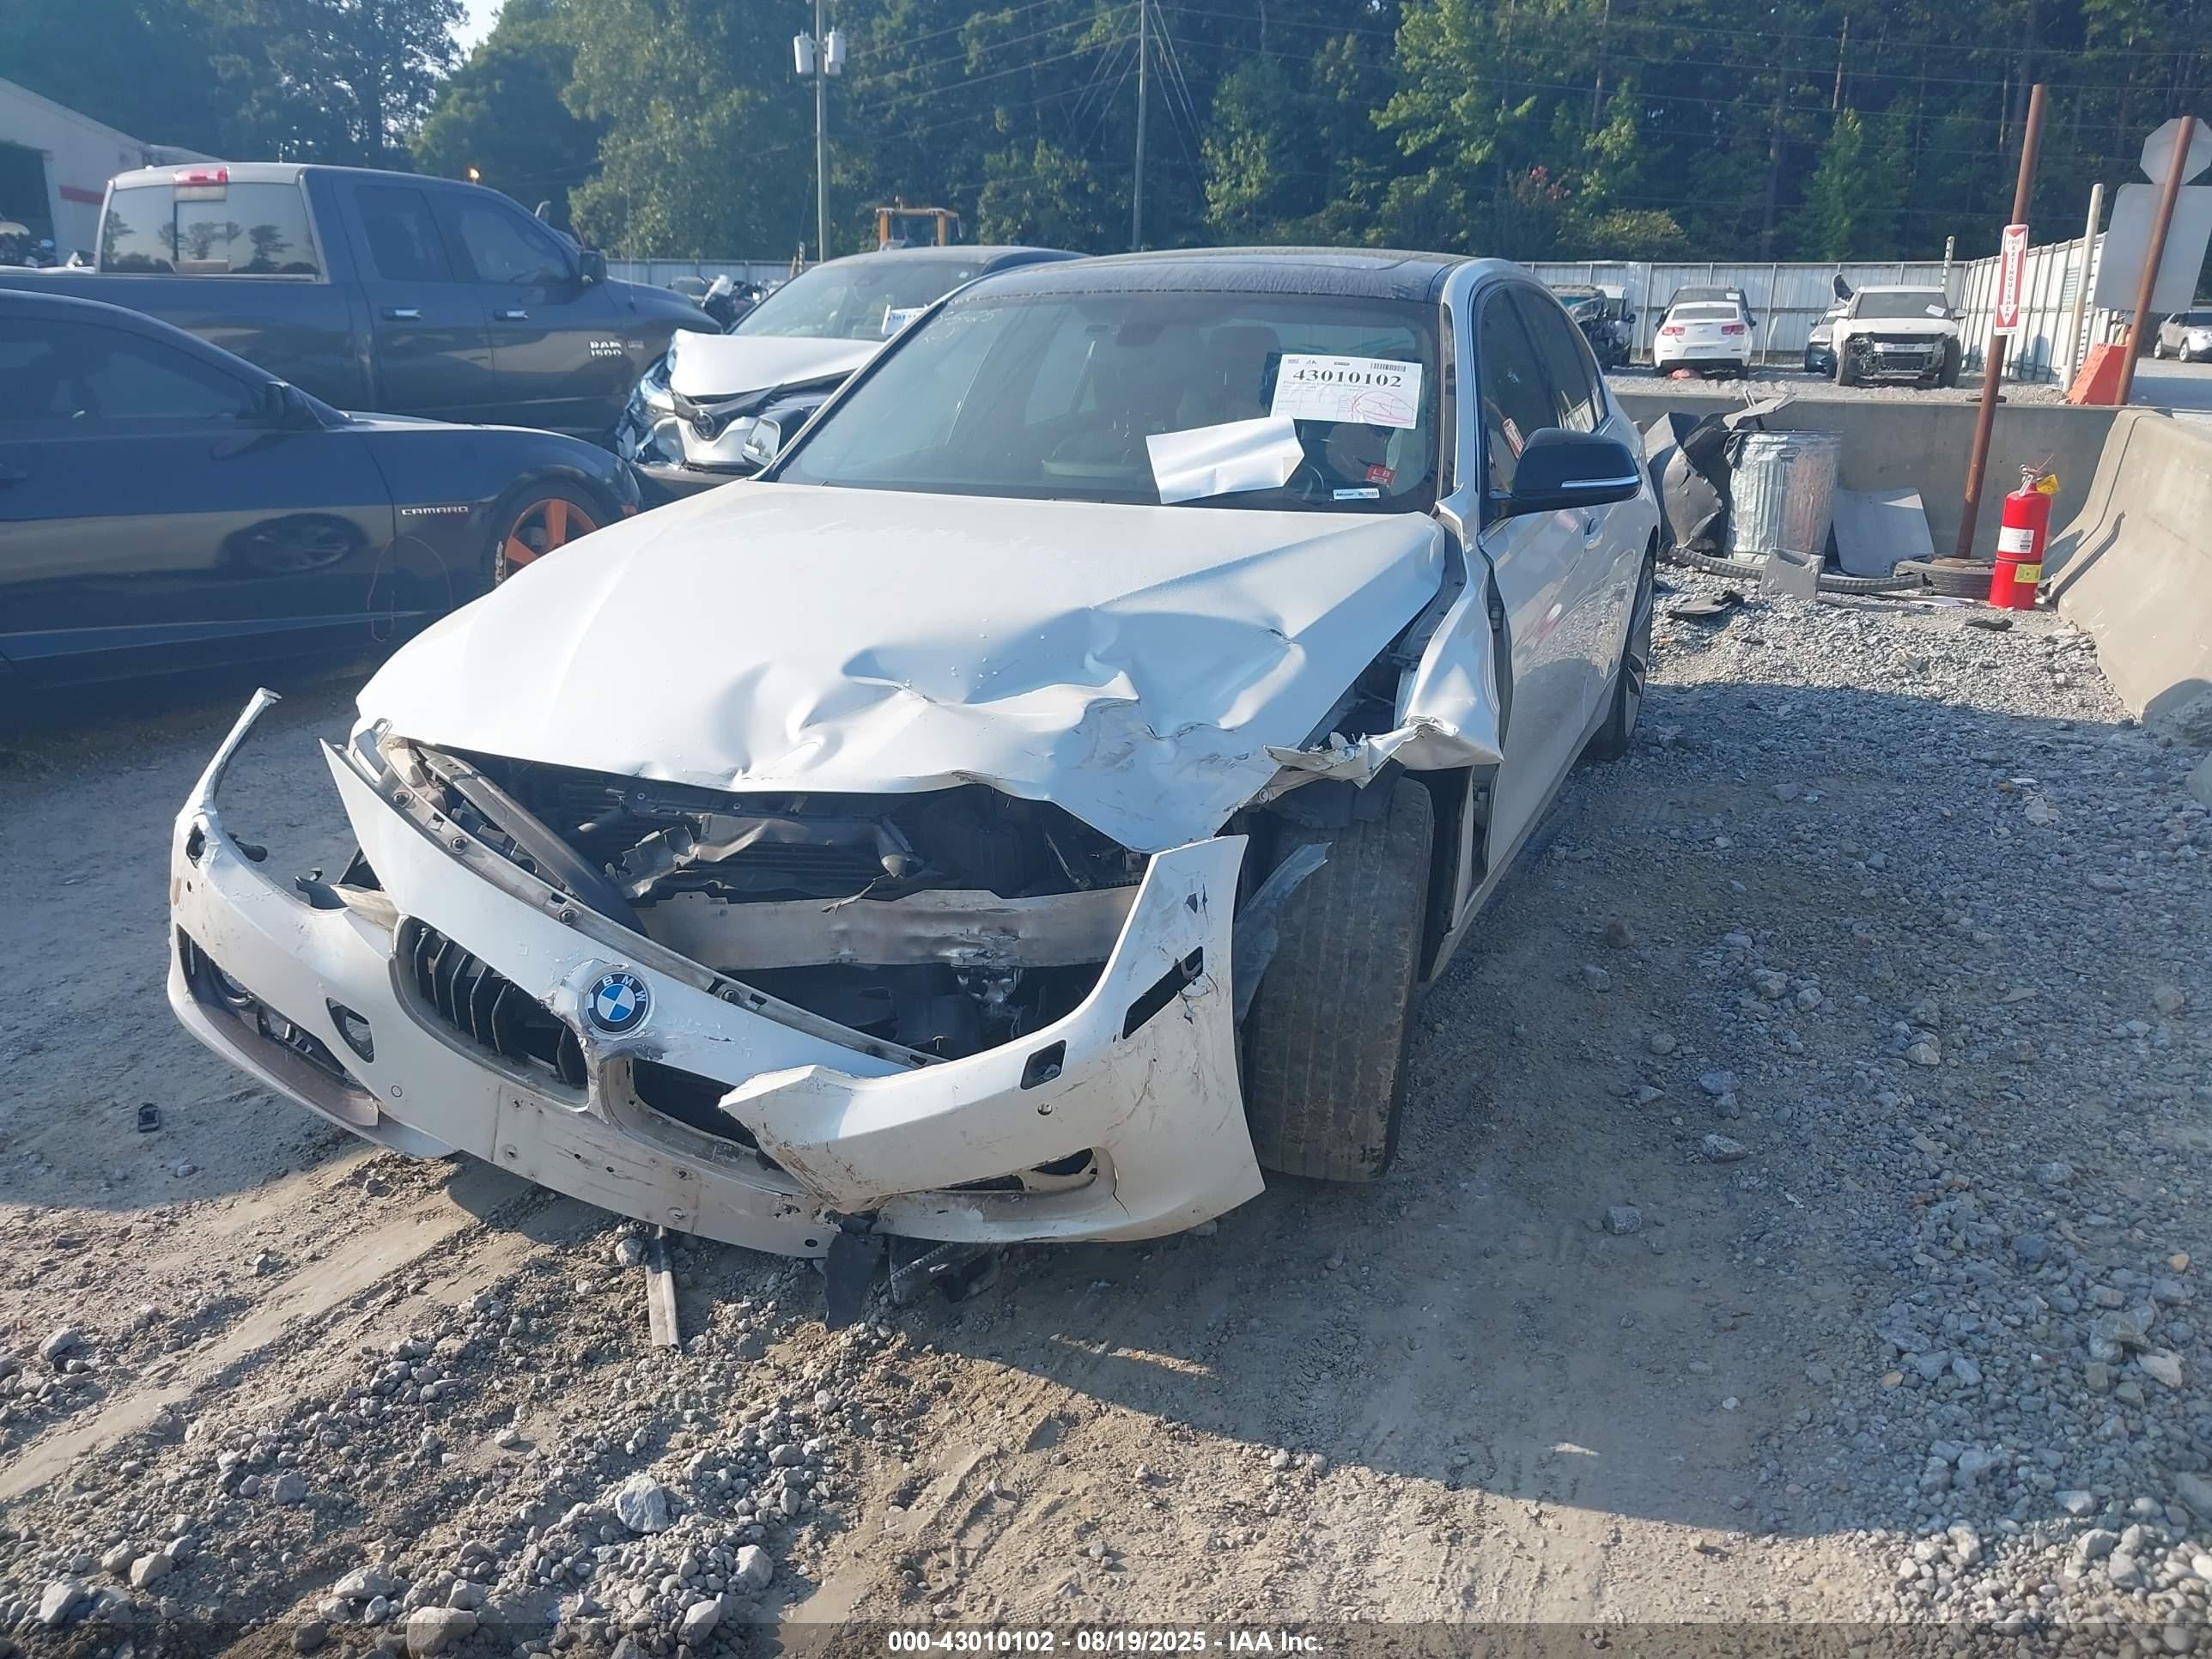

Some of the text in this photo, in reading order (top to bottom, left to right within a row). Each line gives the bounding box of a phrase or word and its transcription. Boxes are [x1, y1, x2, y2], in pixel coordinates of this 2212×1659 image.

[2005, 246, 2015, 317] EXTINGUISHER
[1292, 369, 1401, 387] 43010102
[401, 506, 468, 515] CAMARO
[603, 975, 646, 1002] BMW
